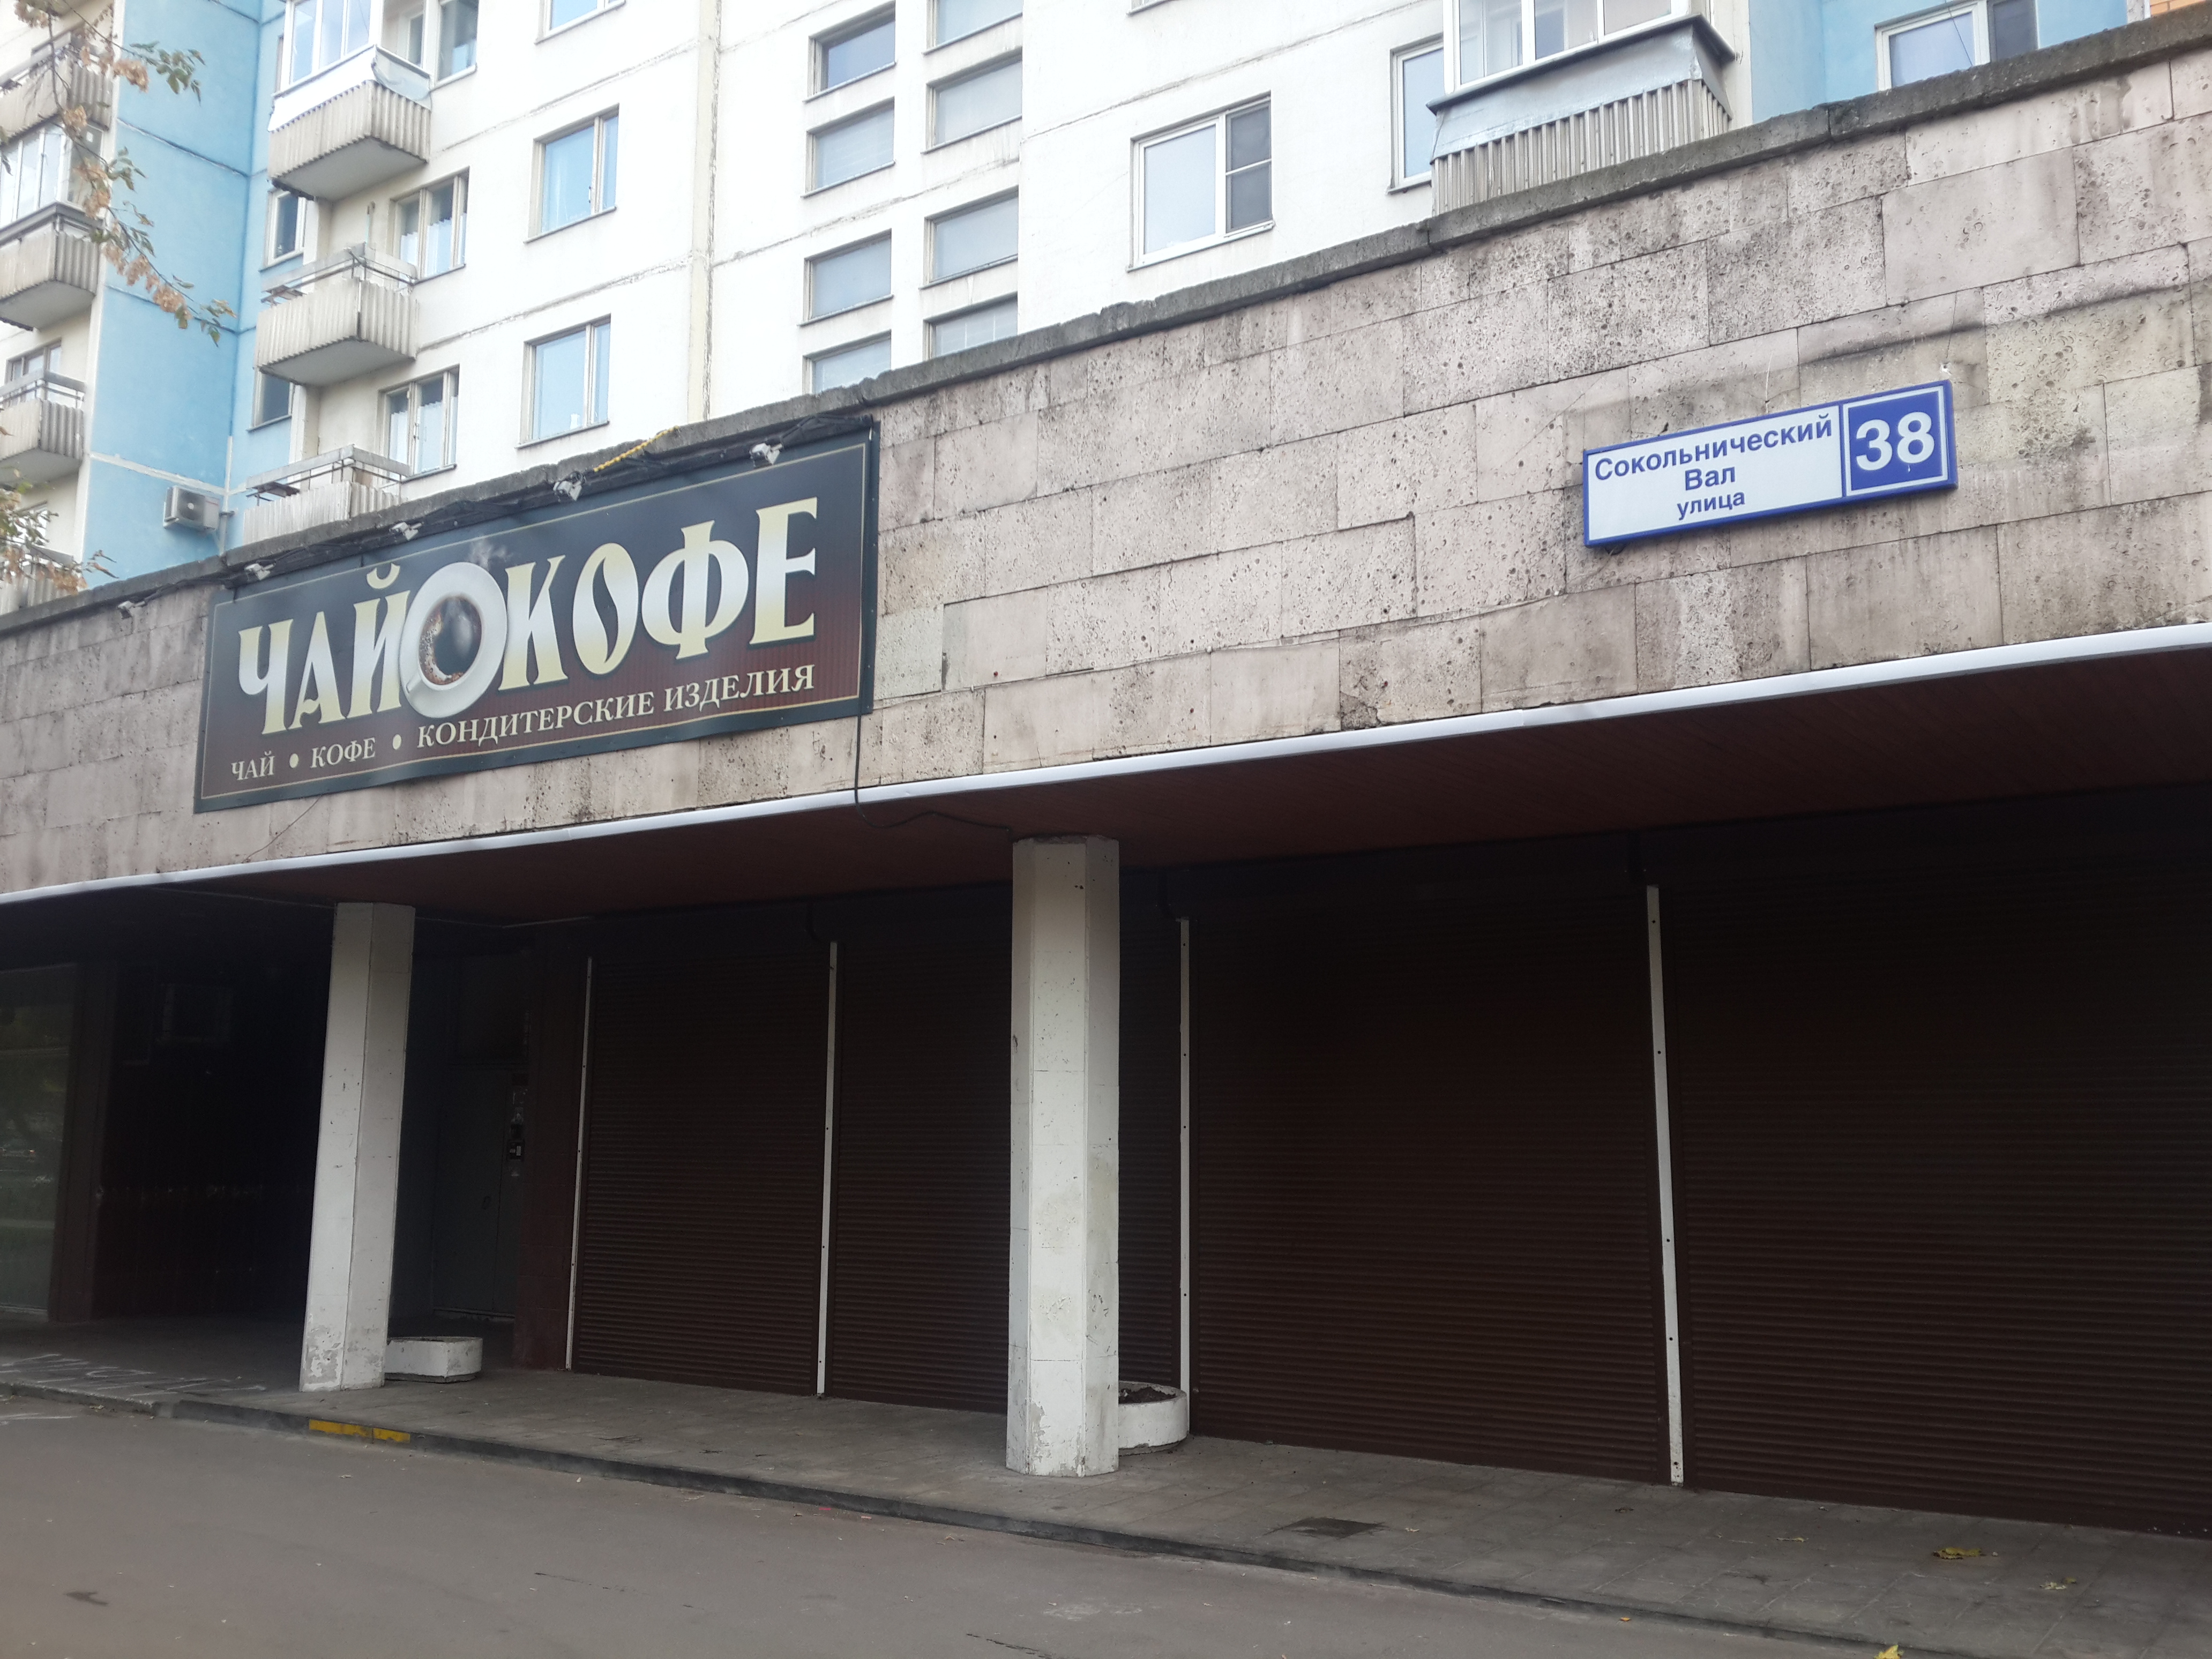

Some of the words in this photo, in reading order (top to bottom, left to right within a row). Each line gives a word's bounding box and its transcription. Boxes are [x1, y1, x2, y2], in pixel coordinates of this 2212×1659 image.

[1595, 414, 1833, 481] Сокольнический
[1855, 410, 1935, 471] 38
[1676, 490, 1745, 520] улица
[1685, 465, 1736, 491] Вал
[230, 751, 275, 781] ЧАЙ
[310, 737, 376, 768] КОФЕ
[417, 691, 655, 749] КОНДИТЕРСКИЕ
[663, 664, 816, 712] ИЗДЕЛИЯ
